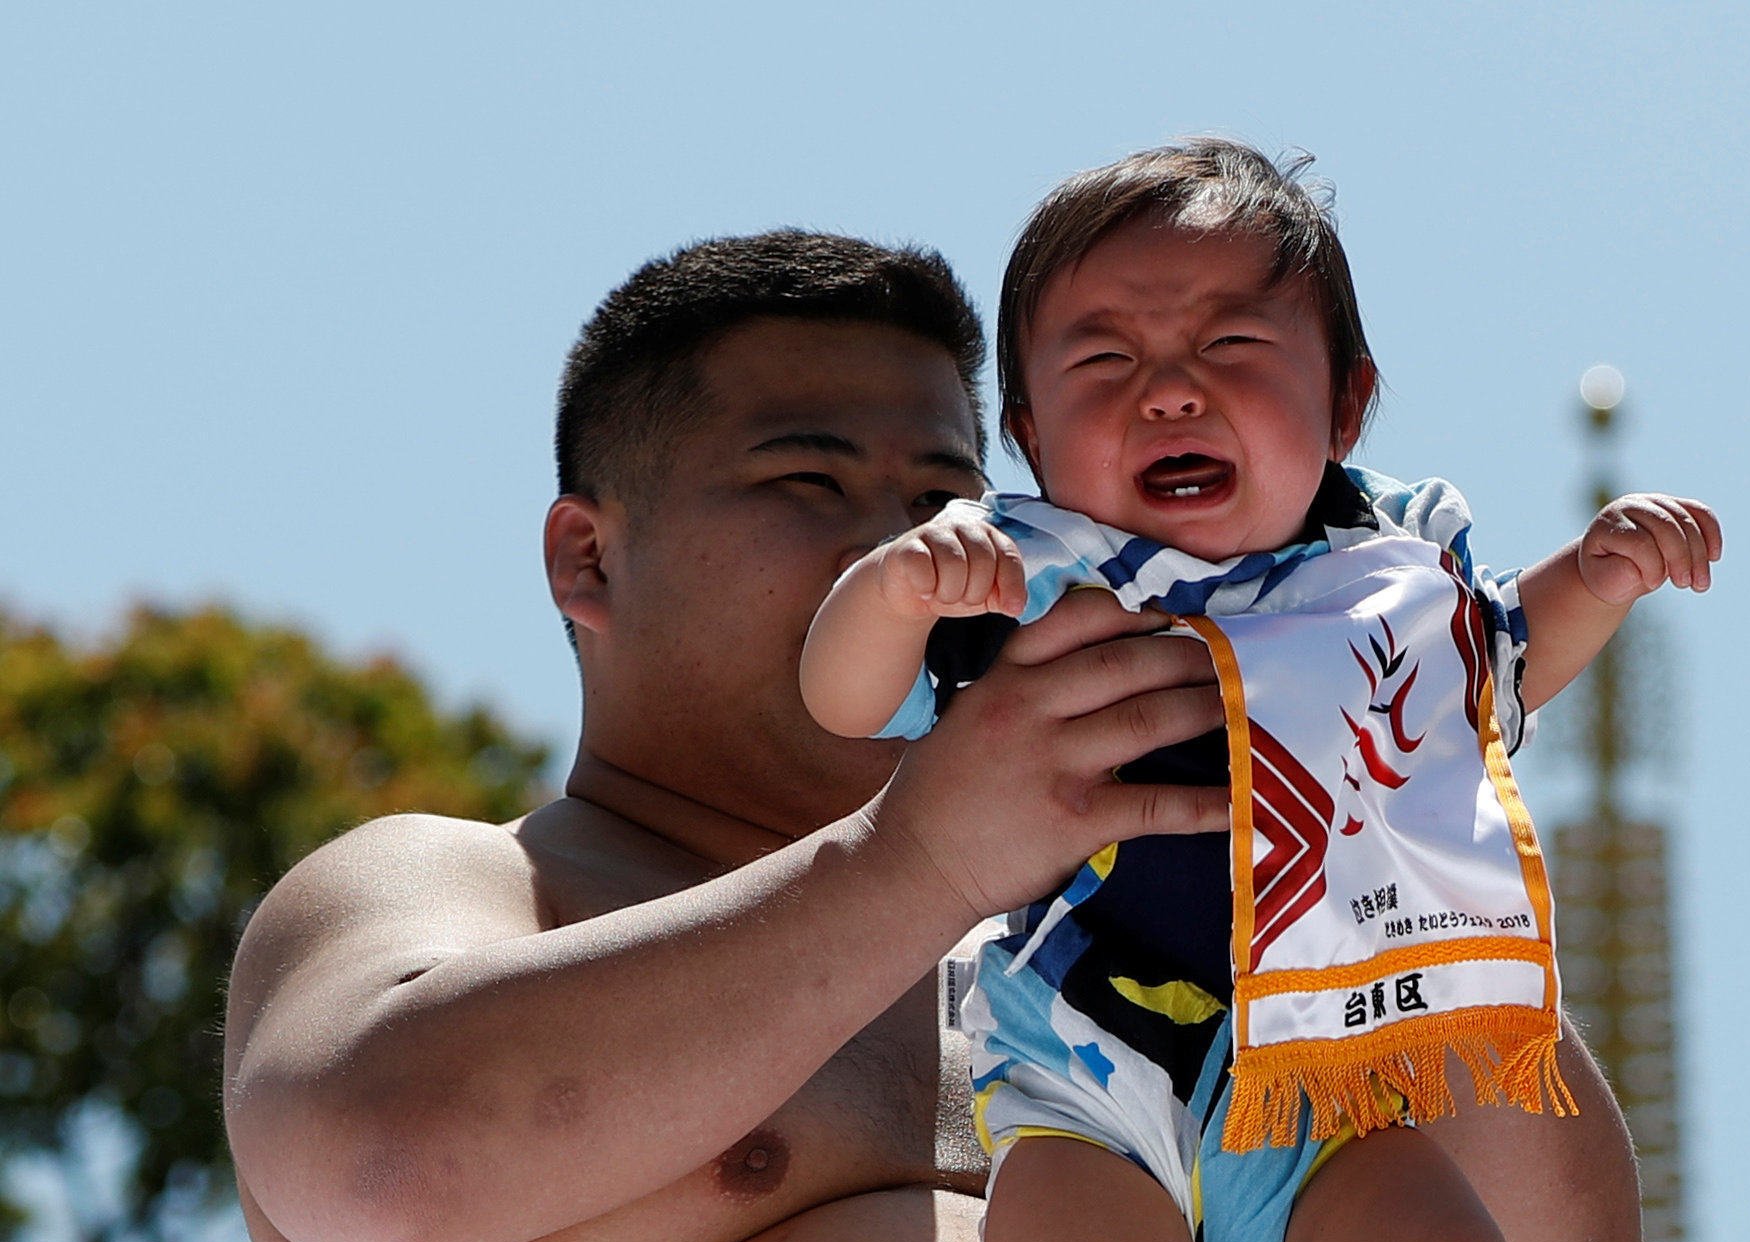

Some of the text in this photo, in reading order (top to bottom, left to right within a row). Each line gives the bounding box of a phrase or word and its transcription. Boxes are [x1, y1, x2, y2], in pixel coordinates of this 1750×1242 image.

[1497, 914, 1530, 928] 2018
[1344, 973, 1429, 1028] 台東区
